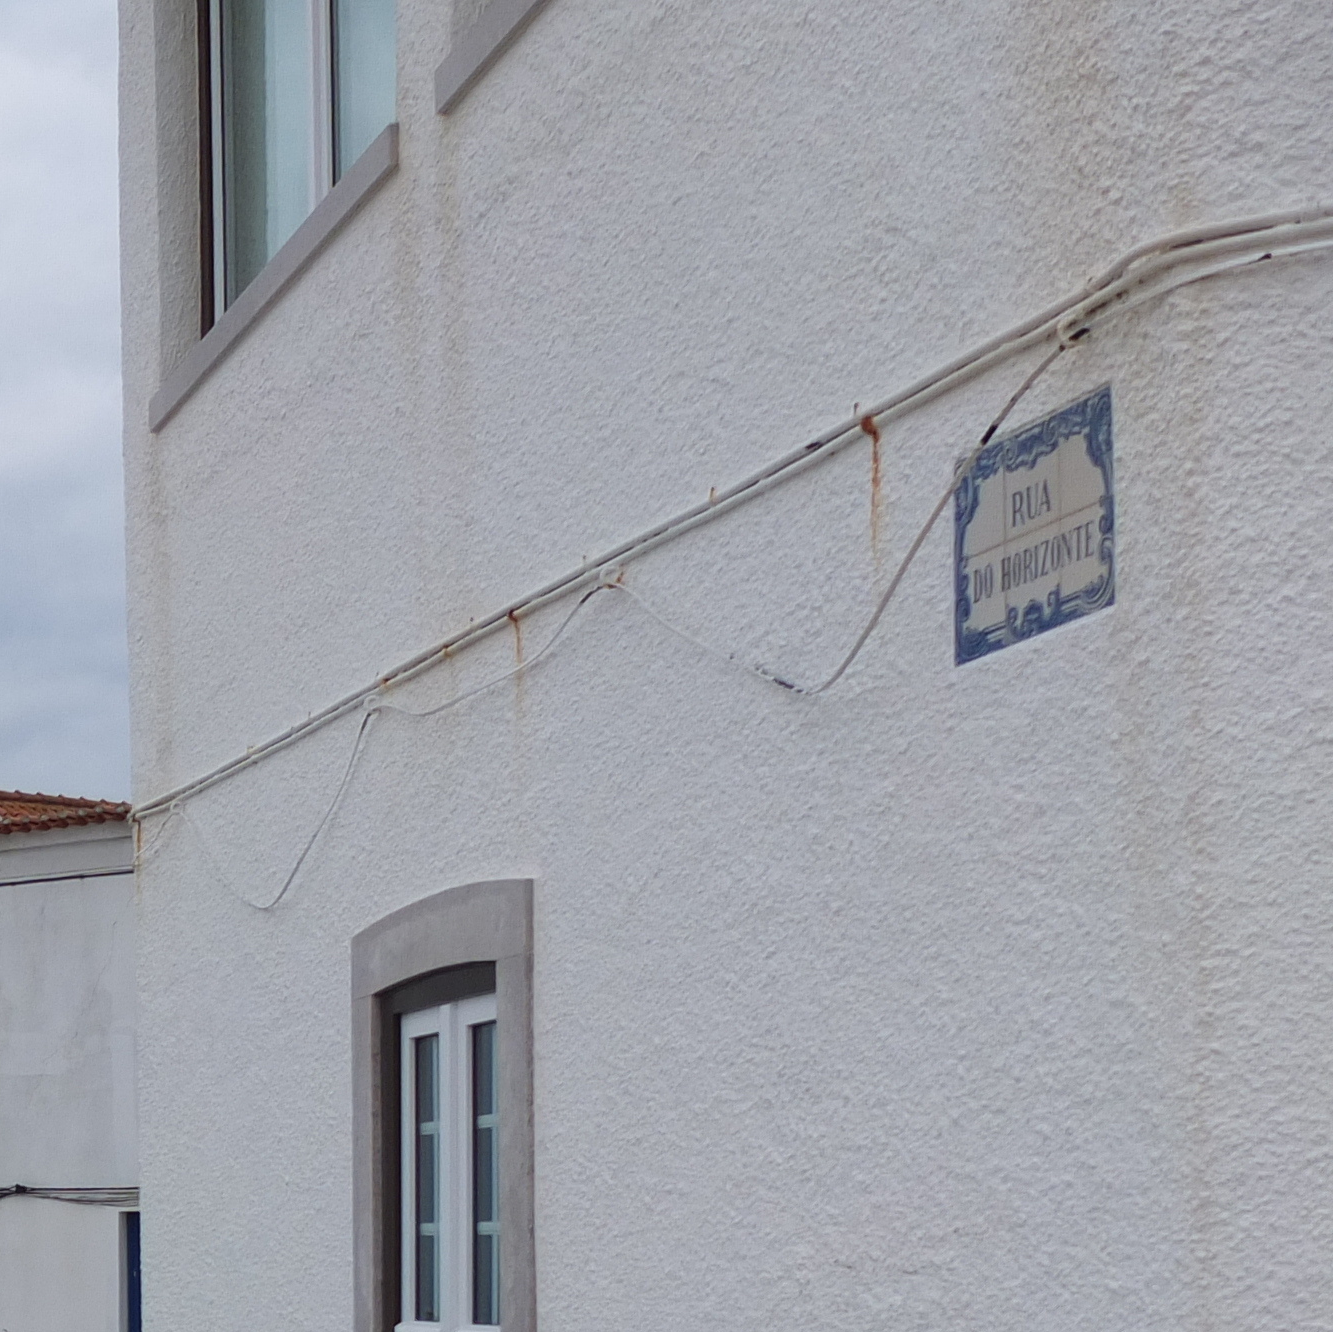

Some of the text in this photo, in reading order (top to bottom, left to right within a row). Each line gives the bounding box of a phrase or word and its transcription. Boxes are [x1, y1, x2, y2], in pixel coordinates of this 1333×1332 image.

[1011, 479, 1051, 528] RUA
[973, 521, 1095, 604] DO HORIZONTE
